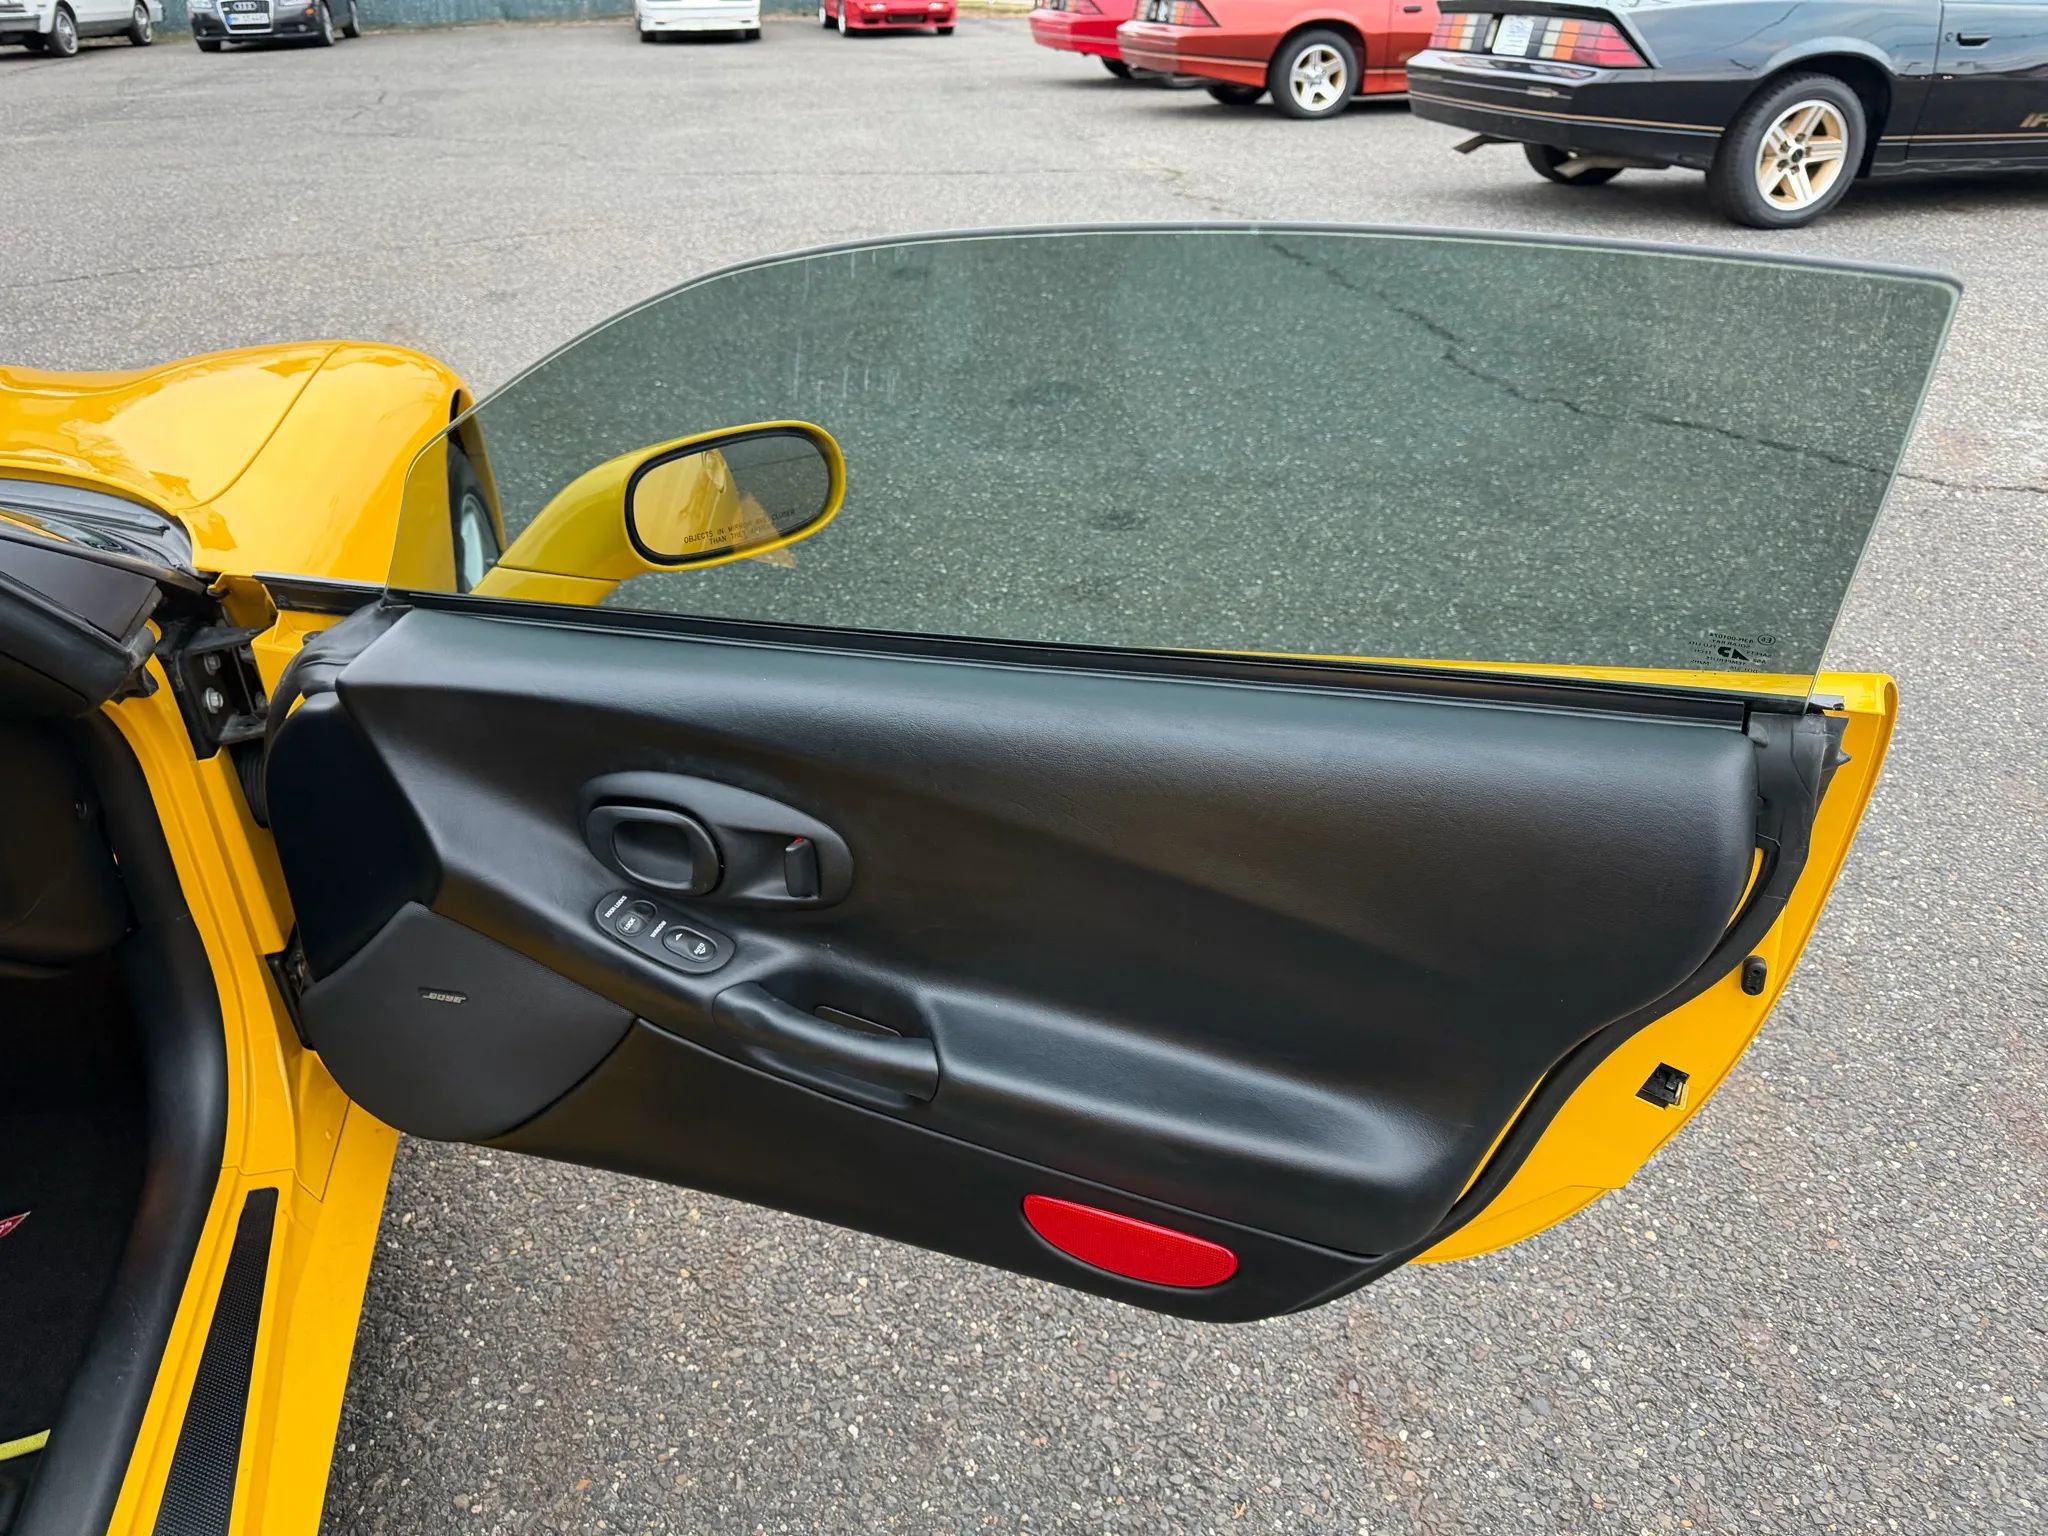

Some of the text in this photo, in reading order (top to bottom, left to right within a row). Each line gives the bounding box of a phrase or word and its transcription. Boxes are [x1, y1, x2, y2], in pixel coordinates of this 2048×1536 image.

[683, 531, 714, 544] OBJECTS
[717, 528, 725, 536] IN
[709, 535, 728, 545] THAN
[623, 916, 636, 931] LOCK
